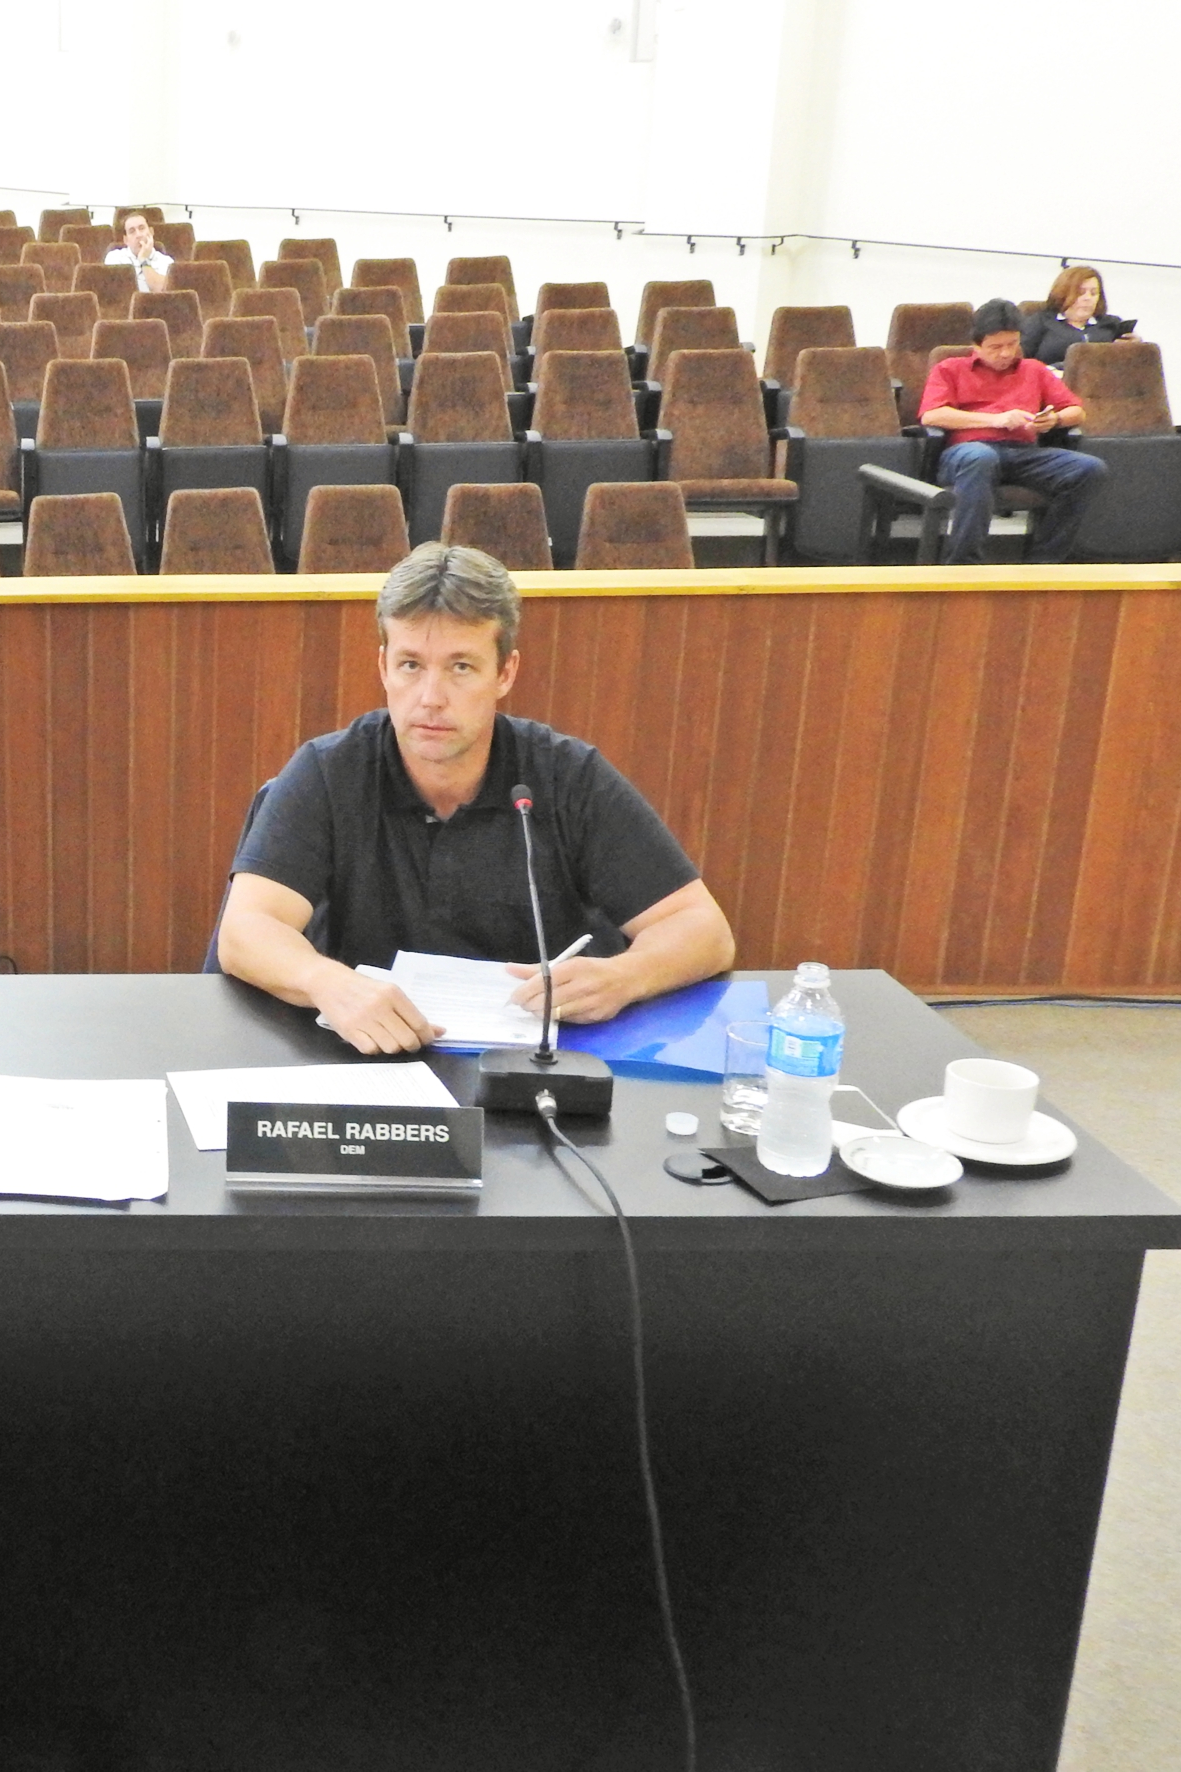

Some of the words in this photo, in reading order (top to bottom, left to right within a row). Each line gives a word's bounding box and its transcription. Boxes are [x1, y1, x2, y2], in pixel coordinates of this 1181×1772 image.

[257, 1120, 340, 1139] RAFAEL
[345, 1122, 450, 1143] RABBERS
[340, 1144, 366, 1155] DEM
